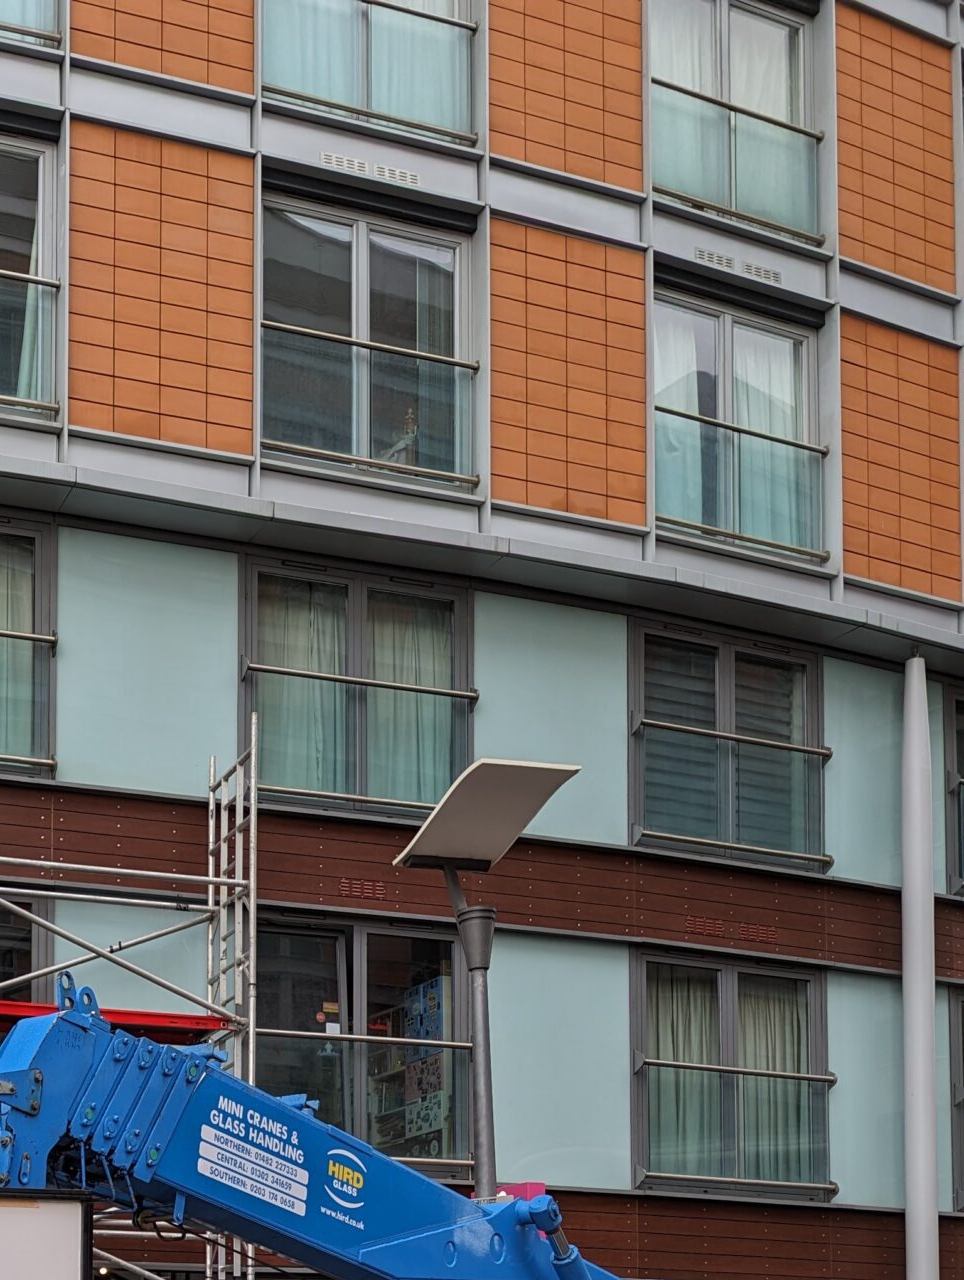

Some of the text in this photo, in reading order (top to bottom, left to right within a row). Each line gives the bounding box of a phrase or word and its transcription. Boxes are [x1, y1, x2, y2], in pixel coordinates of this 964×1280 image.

[218, 1095, 299, 1145] MINI CRANES &
[210, 1109, 304, 1164] GLASS HANDLING
[213, 1133, 253, 1158] NORTHERN:
[254, 1151, 273, 1167] 01482
[216, 1151, 249, 1173] CENTRAL:
[328, 1159, 364, 1189] HIRD
[209, 1165, 248, 1190] SOUTHERN:
[332, 1179, 358, 1197] GLASS
[320, 1205, 365, 1231] www.hird.co.uk
